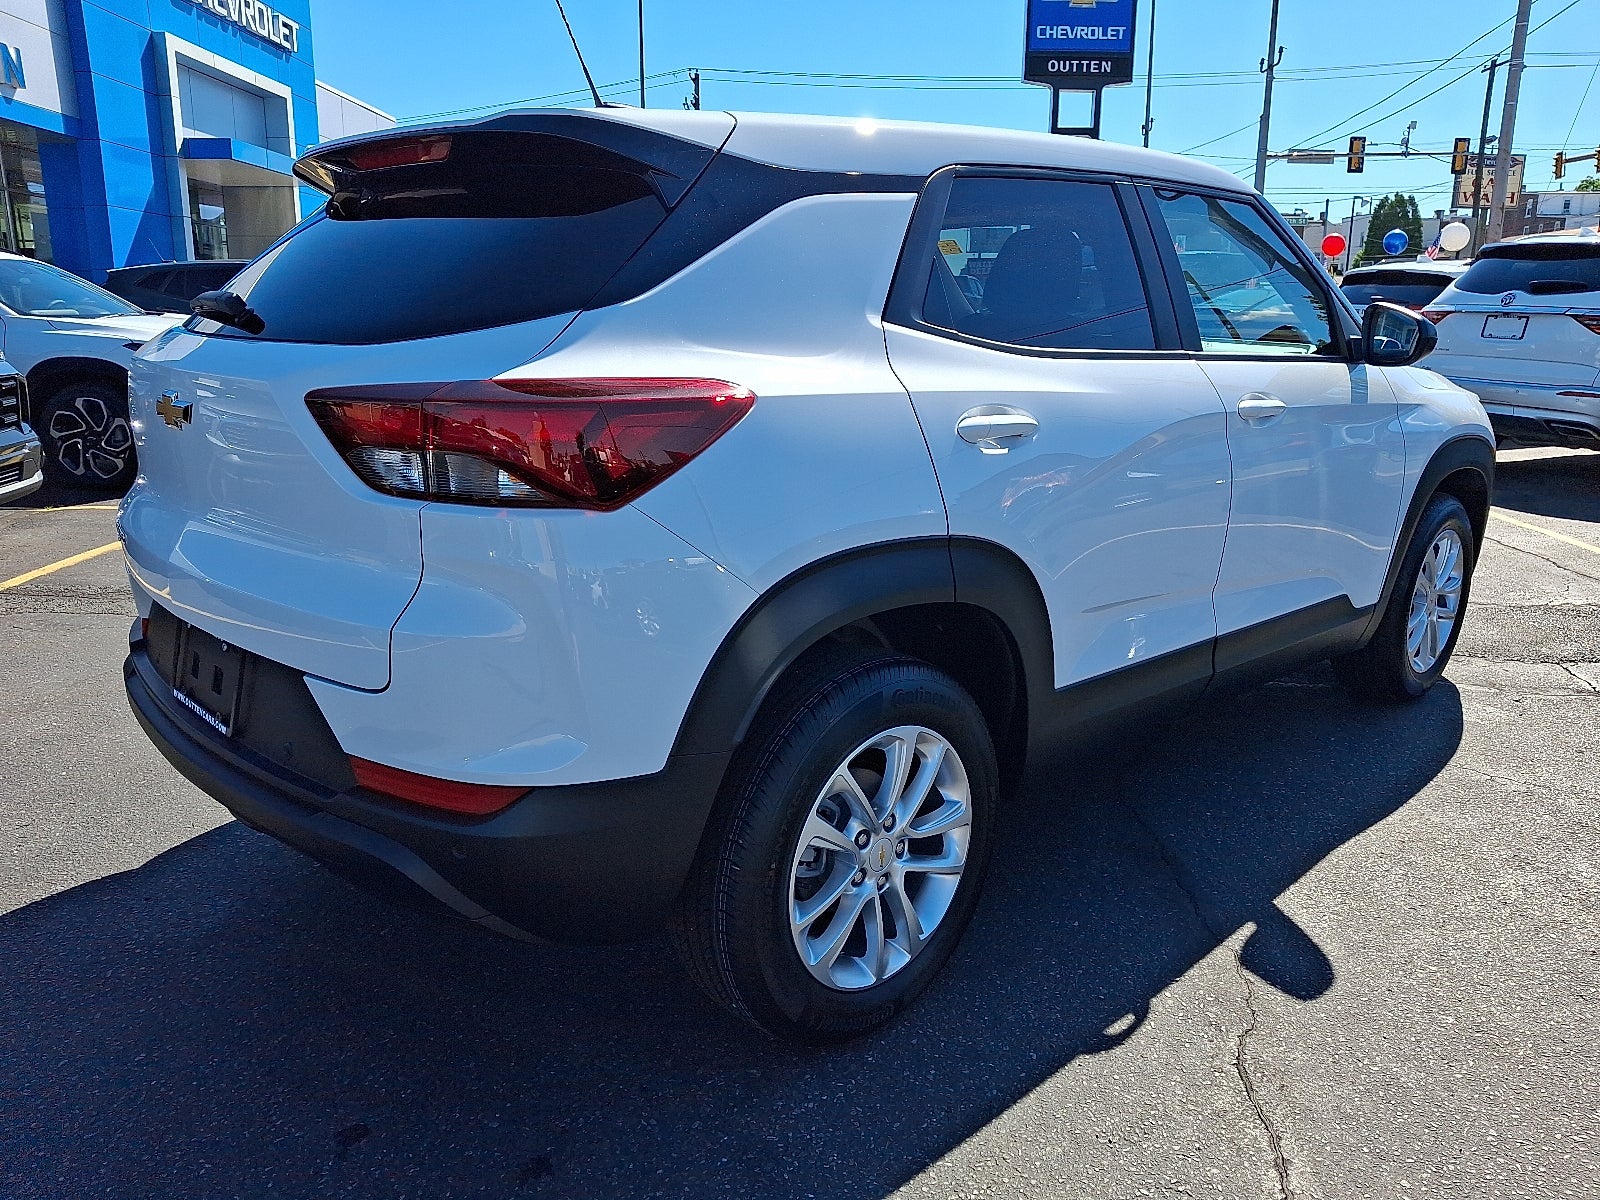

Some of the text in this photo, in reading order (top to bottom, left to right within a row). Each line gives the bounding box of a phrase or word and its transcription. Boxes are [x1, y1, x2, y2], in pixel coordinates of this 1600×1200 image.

[190, 0, 299, 52] VROLET
[1036, 25, 1127, 40] CHEVROLET
[1047, 59, 1112, 73] OUTTEN
[1463, 191, 1516, 204] WAH
